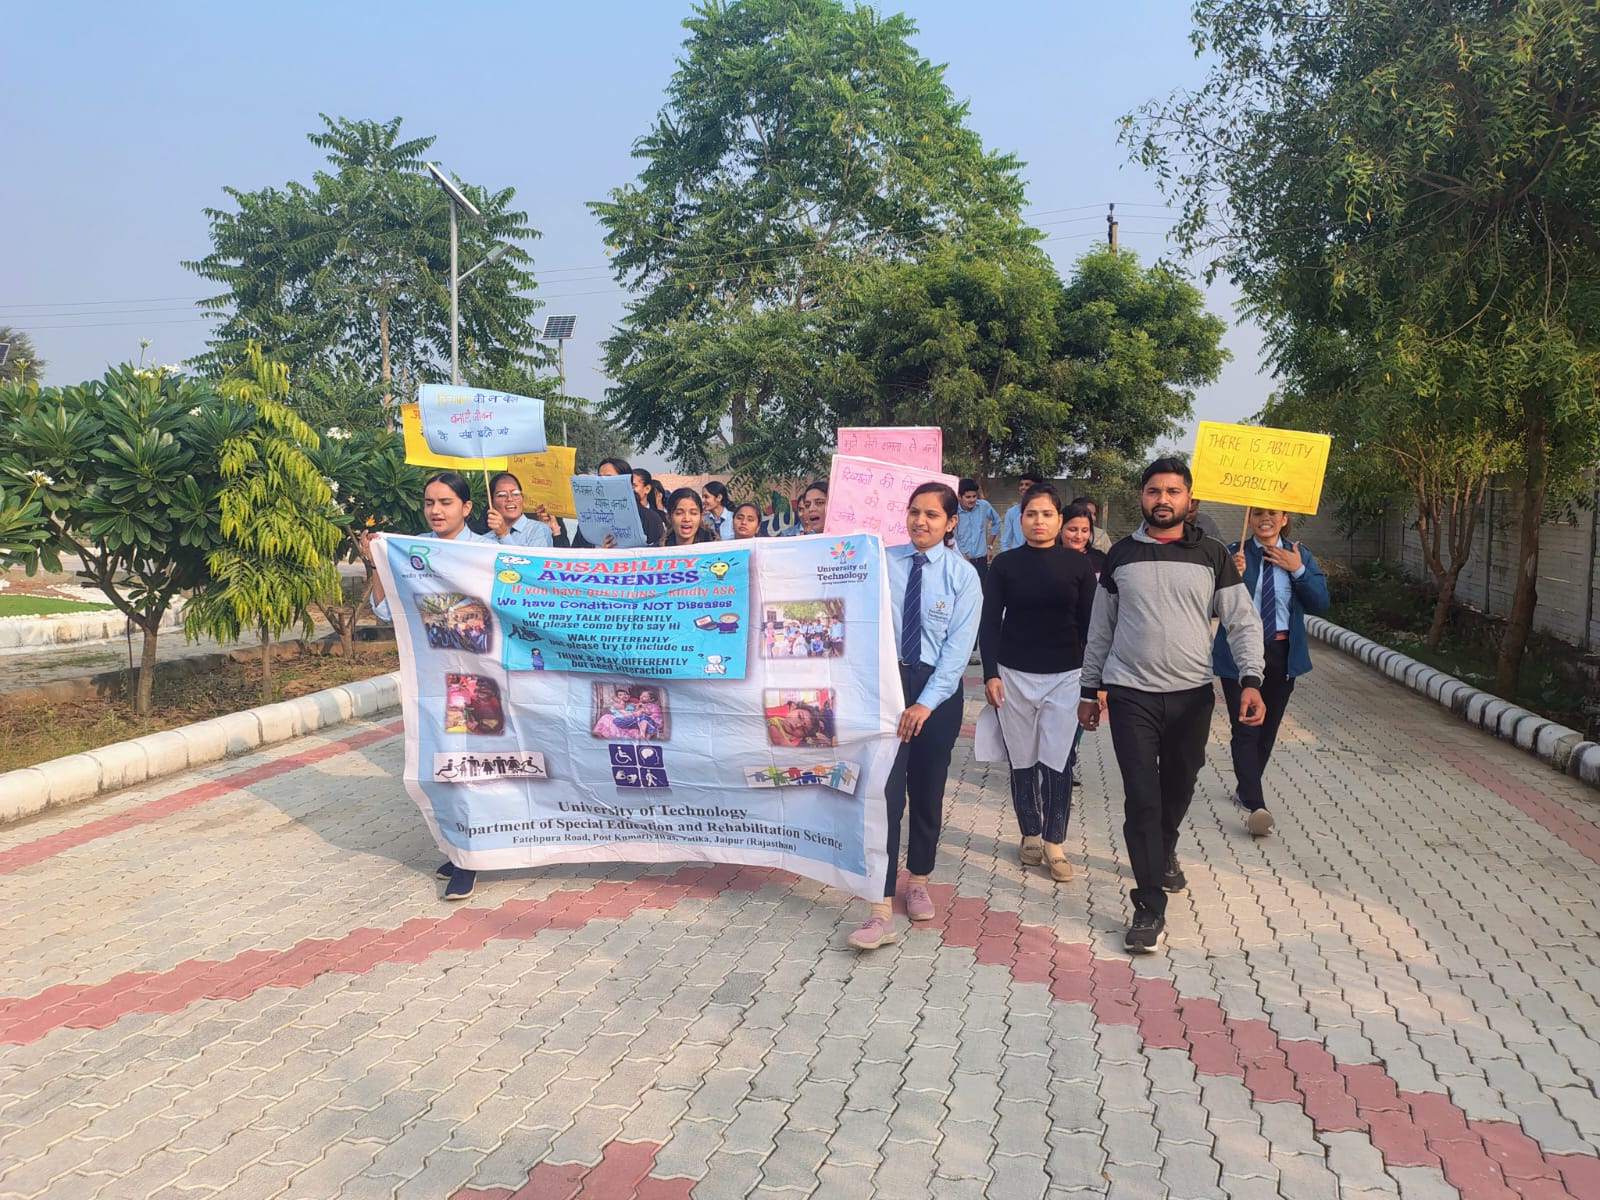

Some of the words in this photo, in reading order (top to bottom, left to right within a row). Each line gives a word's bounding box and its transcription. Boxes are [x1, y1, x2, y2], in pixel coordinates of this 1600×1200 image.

[1209, 433, 1241, 451] THERE
[1250, 438, 1260, 453] IS
[1265, 440, 1314, 459] ABILITY
[1219, 454, 1235, 467] IN
[1244, 456, 1284, 473] EVERY
[1220, 472, 1289, 494] DISABILITY
[543, 557, 698, 573] DISABILITY
[817, 564, 857, 573] University
[537, 570, 699, 586] AWARENESS
[817, 572, 868, 581] Technology
[511, 584, 521, 593] If
[525, 586, 548, 595] you
[552, 586, 582, 596] have
[586, 588, 656, 598] QUESTIONS
[667, 586, 709, 598] Kindly
[712, 585, 735, 595] ASK
[497, 597, 517, 606] We
[522, 598, 555, 607] have
[560, 600, 638, 610] Conditions
[643, 602, 673, 610] NOT
[528, 612, 545, 620] We
[549, 613, 573, 623] may
[575, 614, 601, 622] TALK
[604, 614, 673, 623] DIFFERENTLY
[522, 619, 540, 628] but
[542, 620, 580, 629] please
[582, 622, 613, 630] come
[616, 622, 630, 632] by
[632, 622, 644, 630] to
[646, 623, 666, 631] say
[668, 622, 680, 630] Hi
[567, 633, 597, 642] WALK
[600, 635, 670, 643] DIFFERENTLY
[602, 642, 618, 651] try
[635, 643, 678, 651] include
[557, 651, 584, 660] THINK
[596, 655, 618, 664] PLAY
[621, 657, 689, 666] DIFFERENTLY
[571, 660, 589, 668] but
[590, 661, 614, 670] need
[616, 665, 673, 675] interaction
[558, 801, 634, 819] University
[639, 805, 655, 816] of
[658, 804, 747, 820] Technology
[512, 834, 561, 844] Fatehpura
[564, 833, 591, 842] Road,
[593, 833, 611, 841] Post
[715, 836, 744, 846] Jaipur
[746, 837, 797, 851] (Rajasthan)
[539, 819, 553, 829] of
[556, 818, 602, 831] Special
[607, 820, 673, 831] Education
[678, 822, 702, 832] and
[708, 822, 800, 839] Rehabilitation
[803, 829, 843, 851] Science
